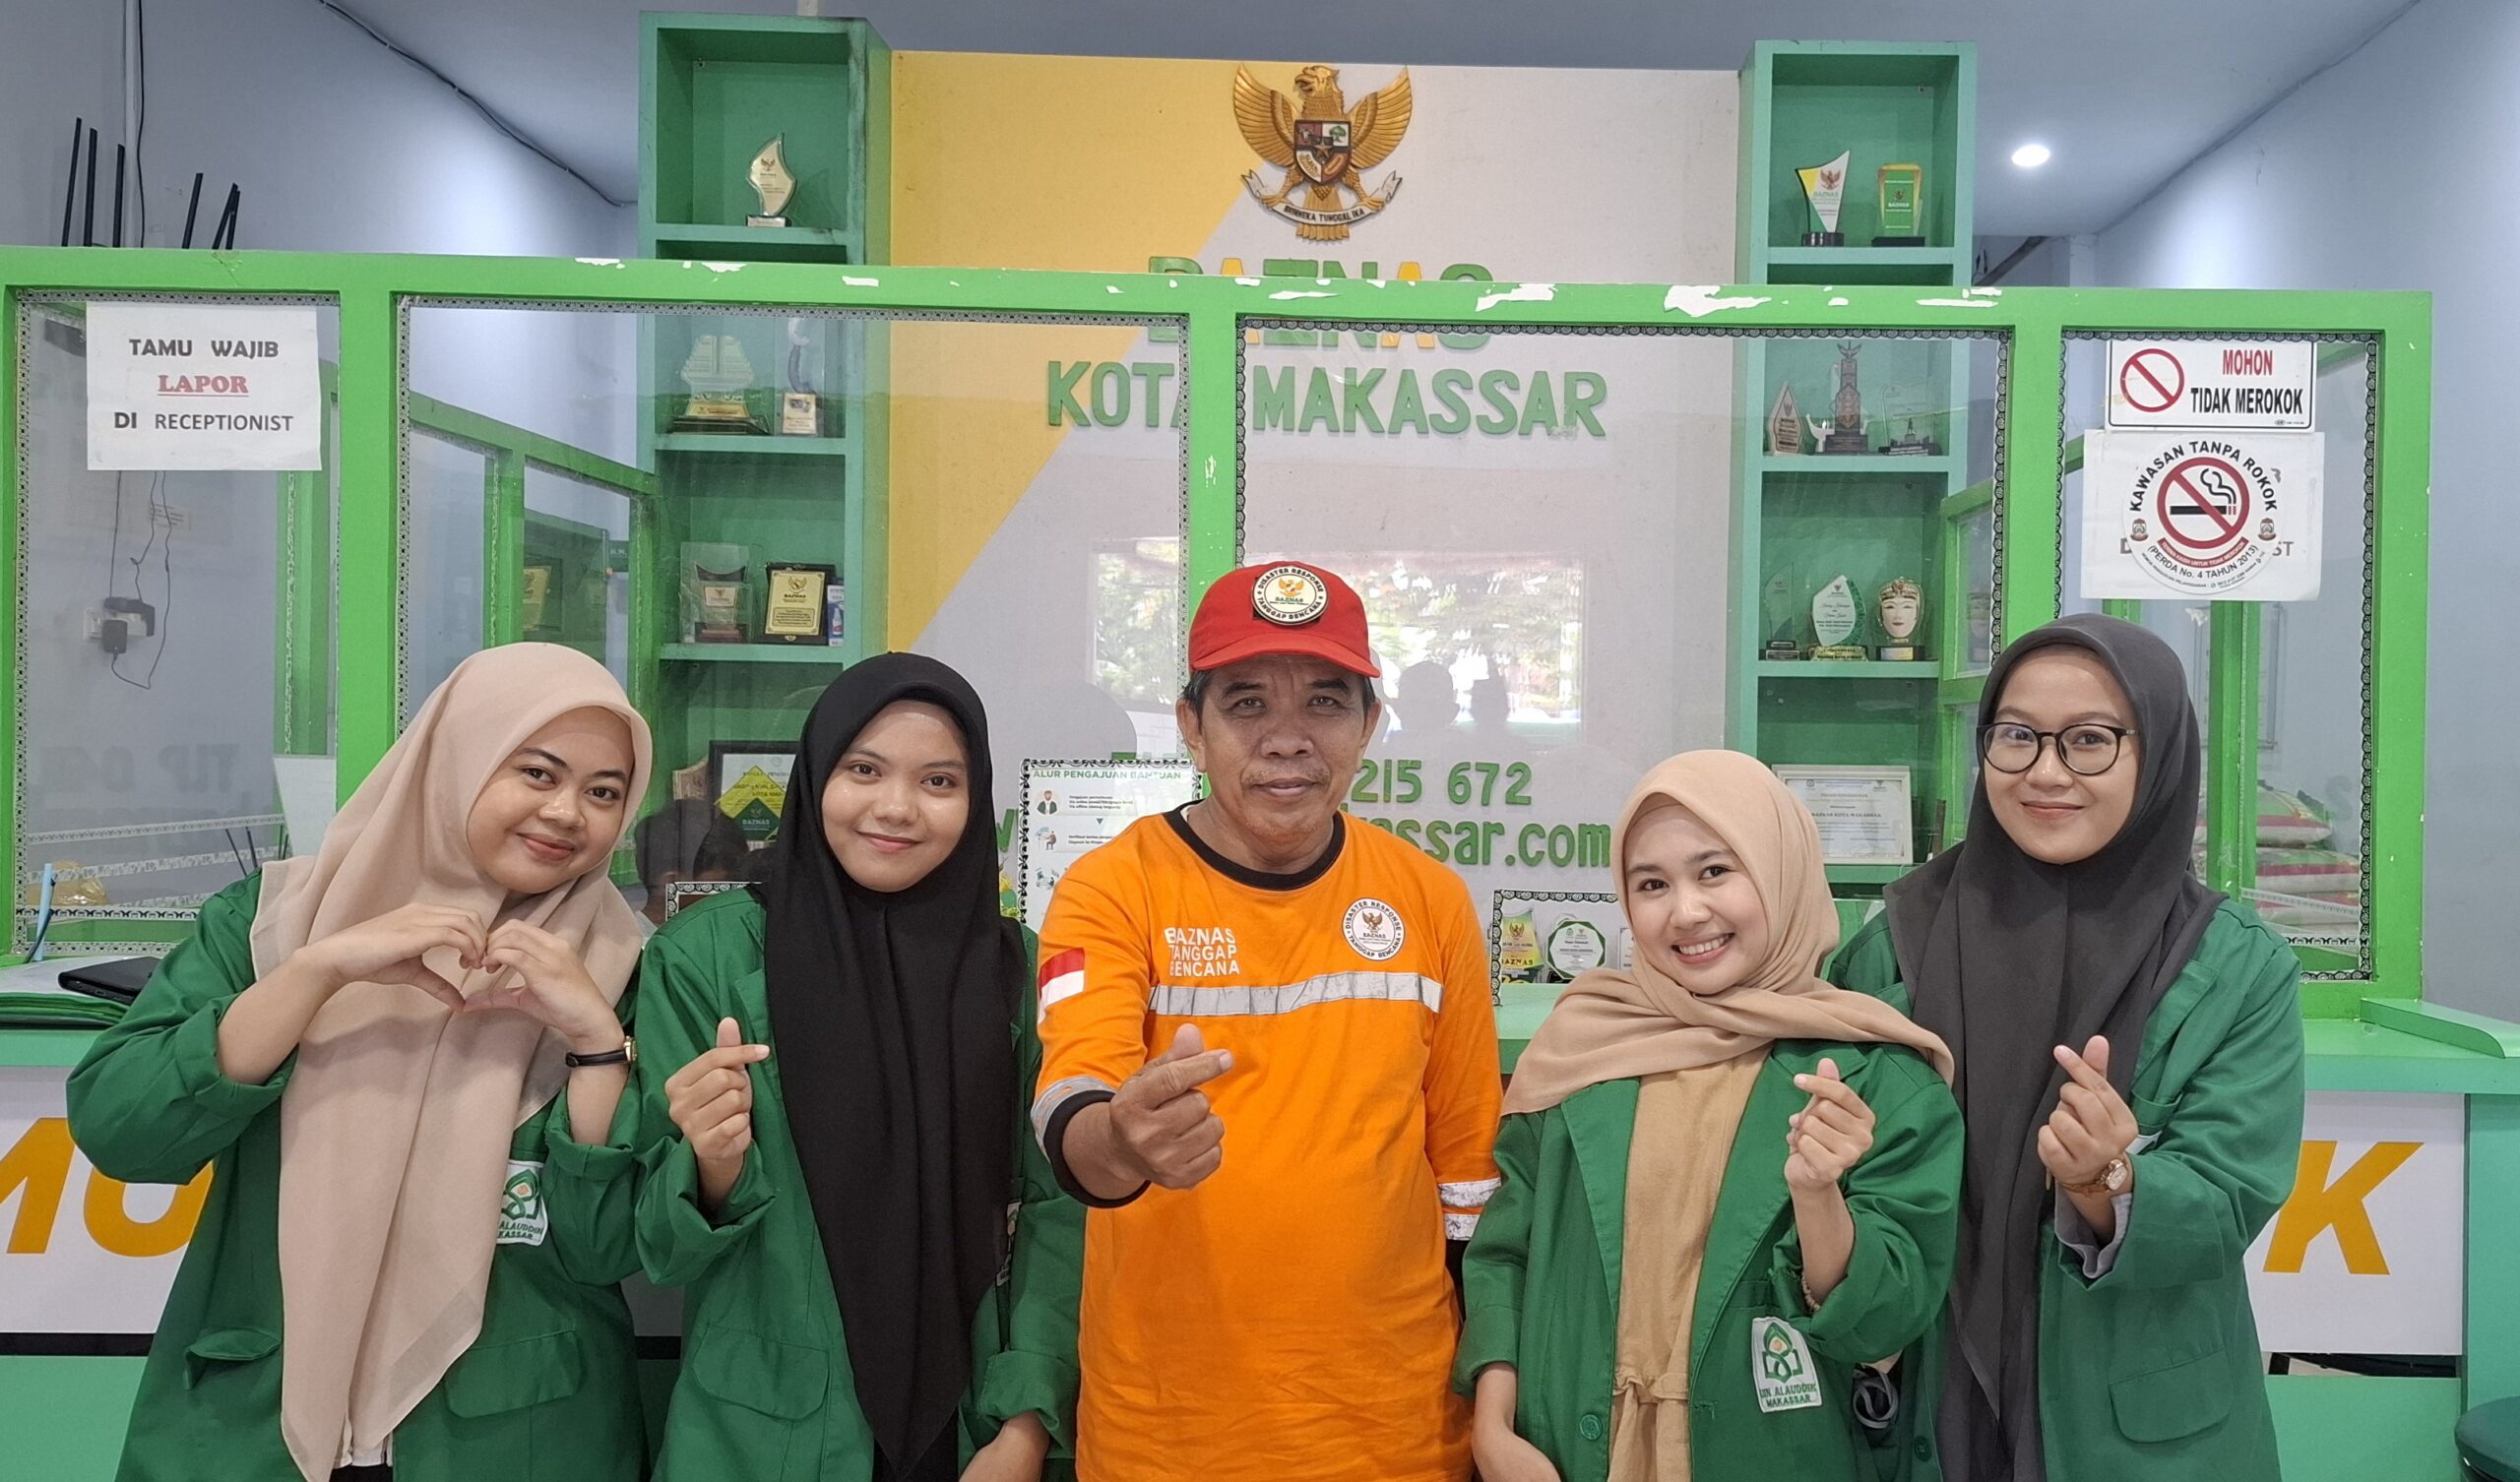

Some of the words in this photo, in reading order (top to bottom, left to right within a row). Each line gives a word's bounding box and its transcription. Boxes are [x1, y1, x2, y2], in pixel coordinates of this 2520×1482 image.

[1351, 208, 1365, 218] IKA
[129, 339, 193, 357] TAMU
[211, 340, 279, 359] WAJIB
[2222, 349, 2273, 376] MOHON
[158, 374, 249, 394] LAPOR
[1047, 360, 1180, 428] KOT
[1253, 365, 1607, 437] MAKASSAR
[2190, 388, 2231, 413] TIDAK
[2235, 388, 2302, 414] MEROKOK
[114, 411, 137, 429] DI
[155, 413, 293, 431] RECEPTIONIST
[2129, 445, 2184, 512] KAWASAN
[2189, 441, 2240, 462] TANPA
[2242, 458, 2278, 512] ROKOK
[2147, 545, 2177, 573] (PERDA
[2205, 563, 2237, 579] TAHUN
[2237, 545, 2259, 566] 2013)
[1447, 762, 1532, 806] 672
[1165, 927, 1236, 946] BAZNAS
[1168, 945, 1237, 961] TANGGAP
[497, 1230, 534, 1239] KASSAR
[499, 1220, 544, 1234] ALAUDDIN
